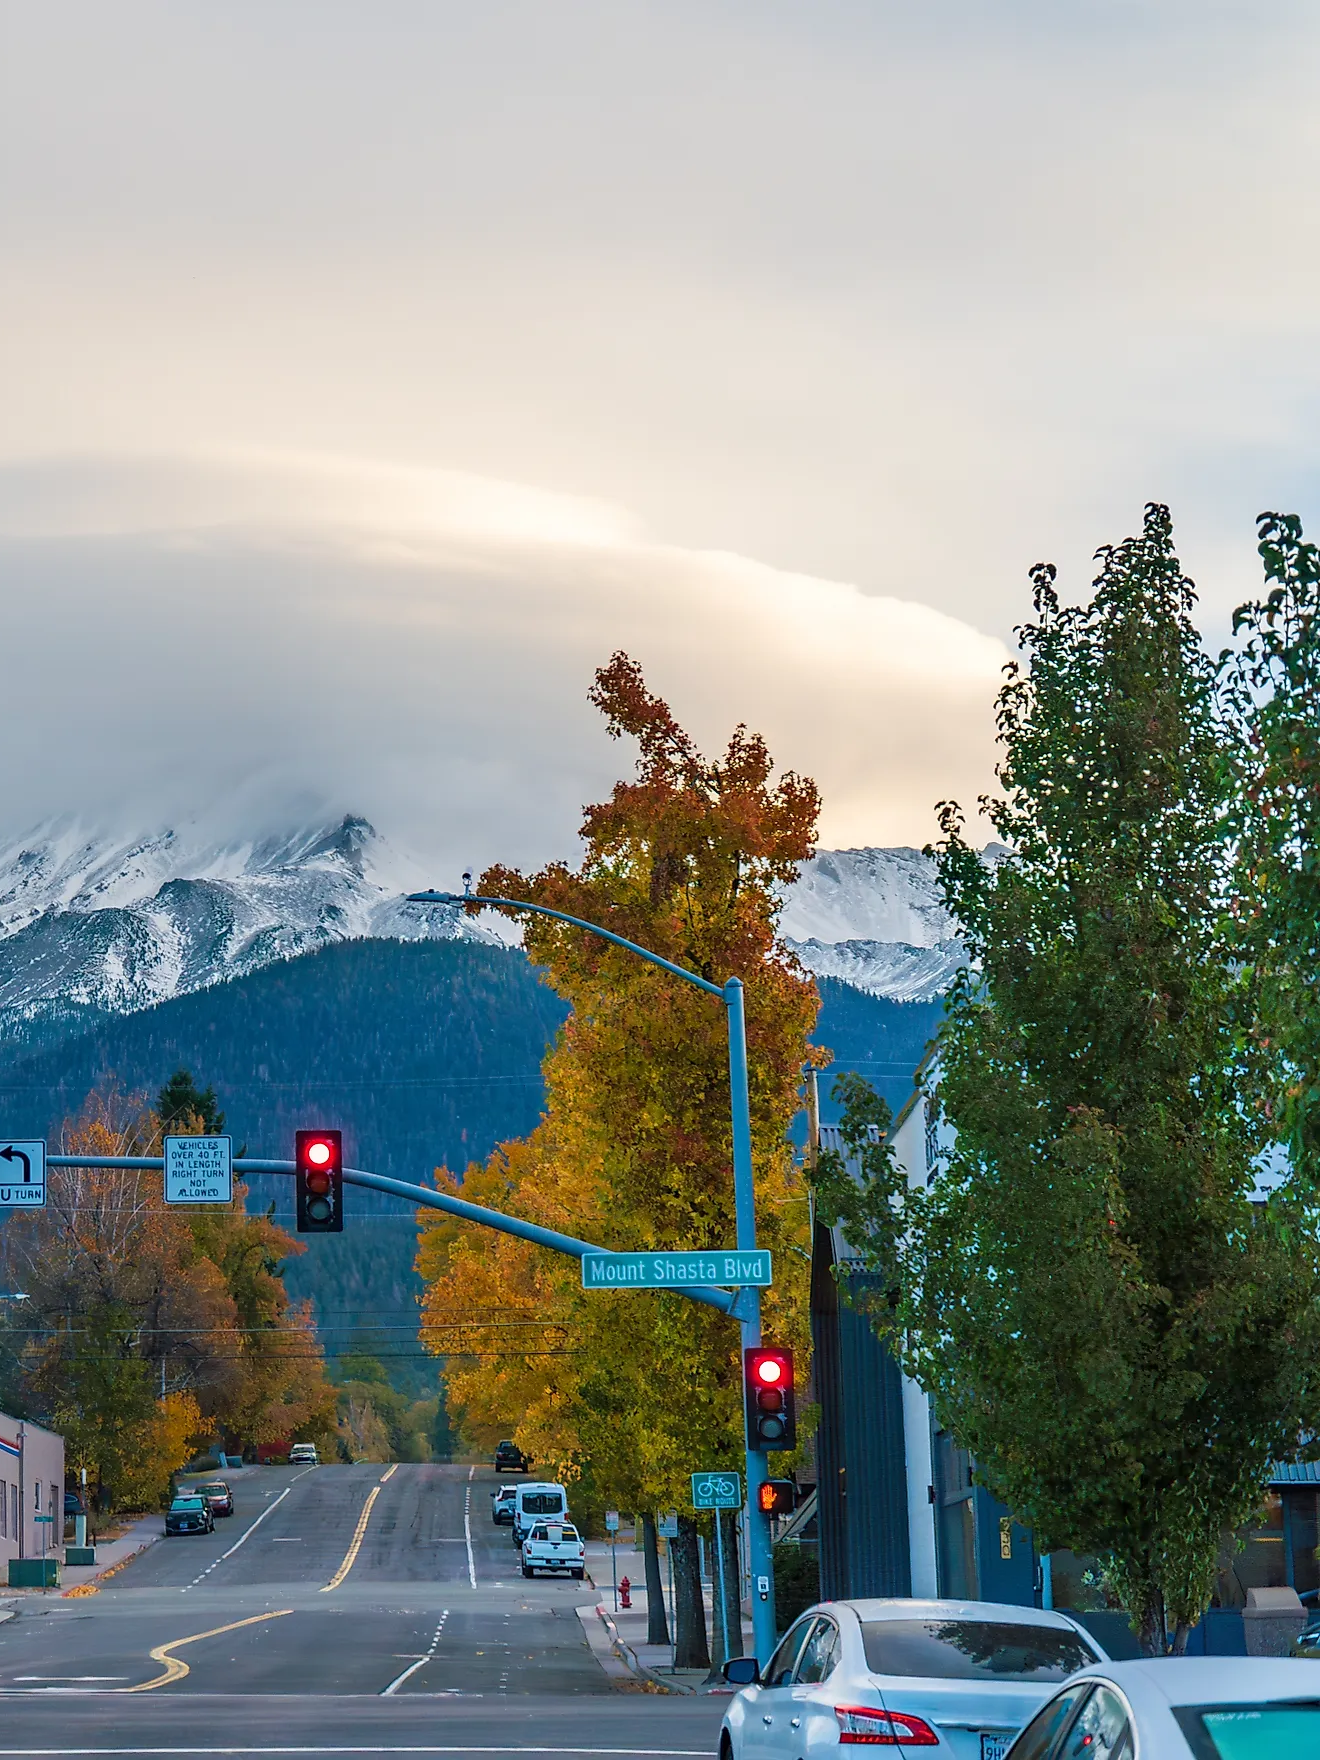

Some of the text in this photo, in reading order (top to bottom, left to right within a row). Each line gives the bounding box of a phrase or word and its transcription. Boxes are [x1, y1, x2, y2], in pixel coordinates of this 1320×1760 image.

[177, 1141, 219, 1150] VEHICLES
[171, 1150, 226, 1159] OVER 40 FT.
[175, 1160, 221, 1169] IN LENGTH
[172, 1169, 224, 1178] RIGHT TURN
[189, 1179, 207, 1188] NOT
[0, 1188, 11, 1201] U
[15, 1190, 41, 1200] TURN
[177, 1188, 219, 1197] ALLOWED
[591, 1258, 762, 1281] Mount Shasta Blvd
[715, 1497, 735, 1505] ROUTE
